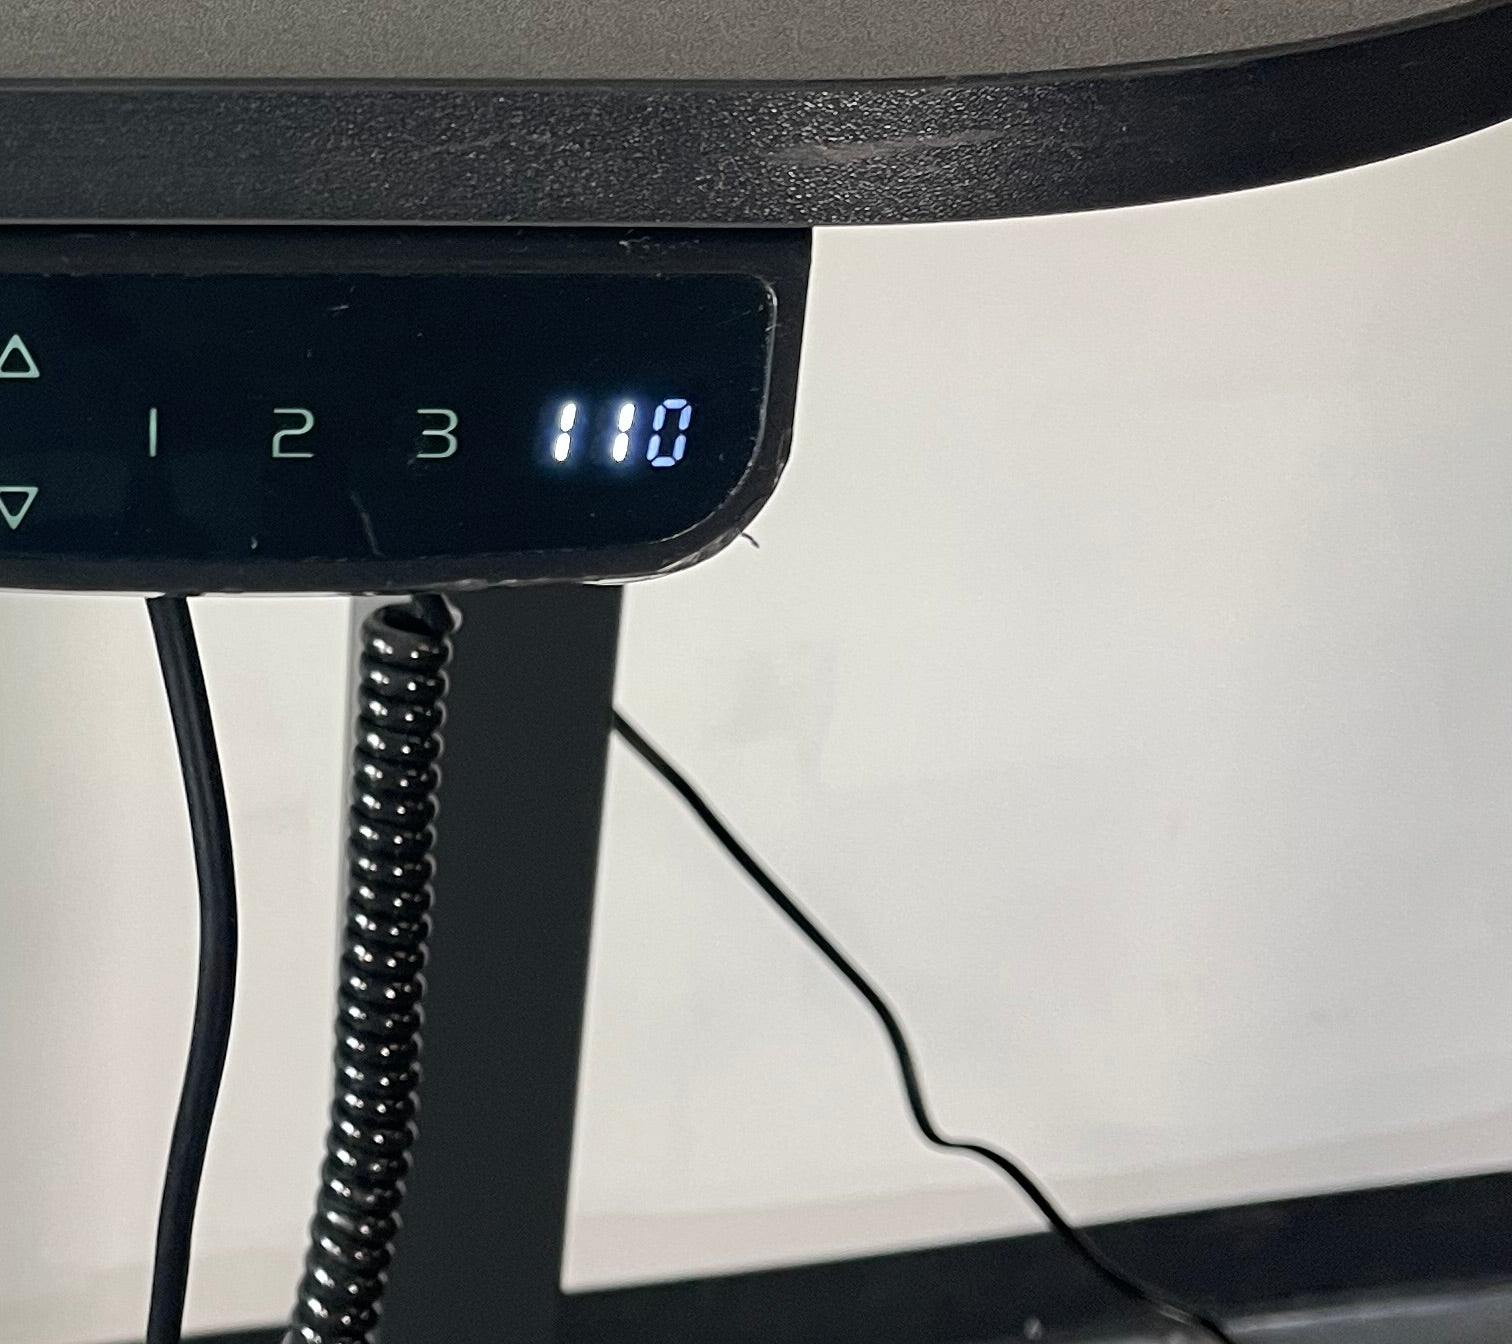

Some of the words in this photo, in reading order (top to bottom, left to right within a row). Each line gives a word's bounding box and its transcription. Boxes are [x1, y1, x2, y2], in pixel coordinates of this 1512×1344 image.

[271, 407, 315, 458] 2
[415, 407, 459, 458] 3
[553, 398, 692, 467] 110
